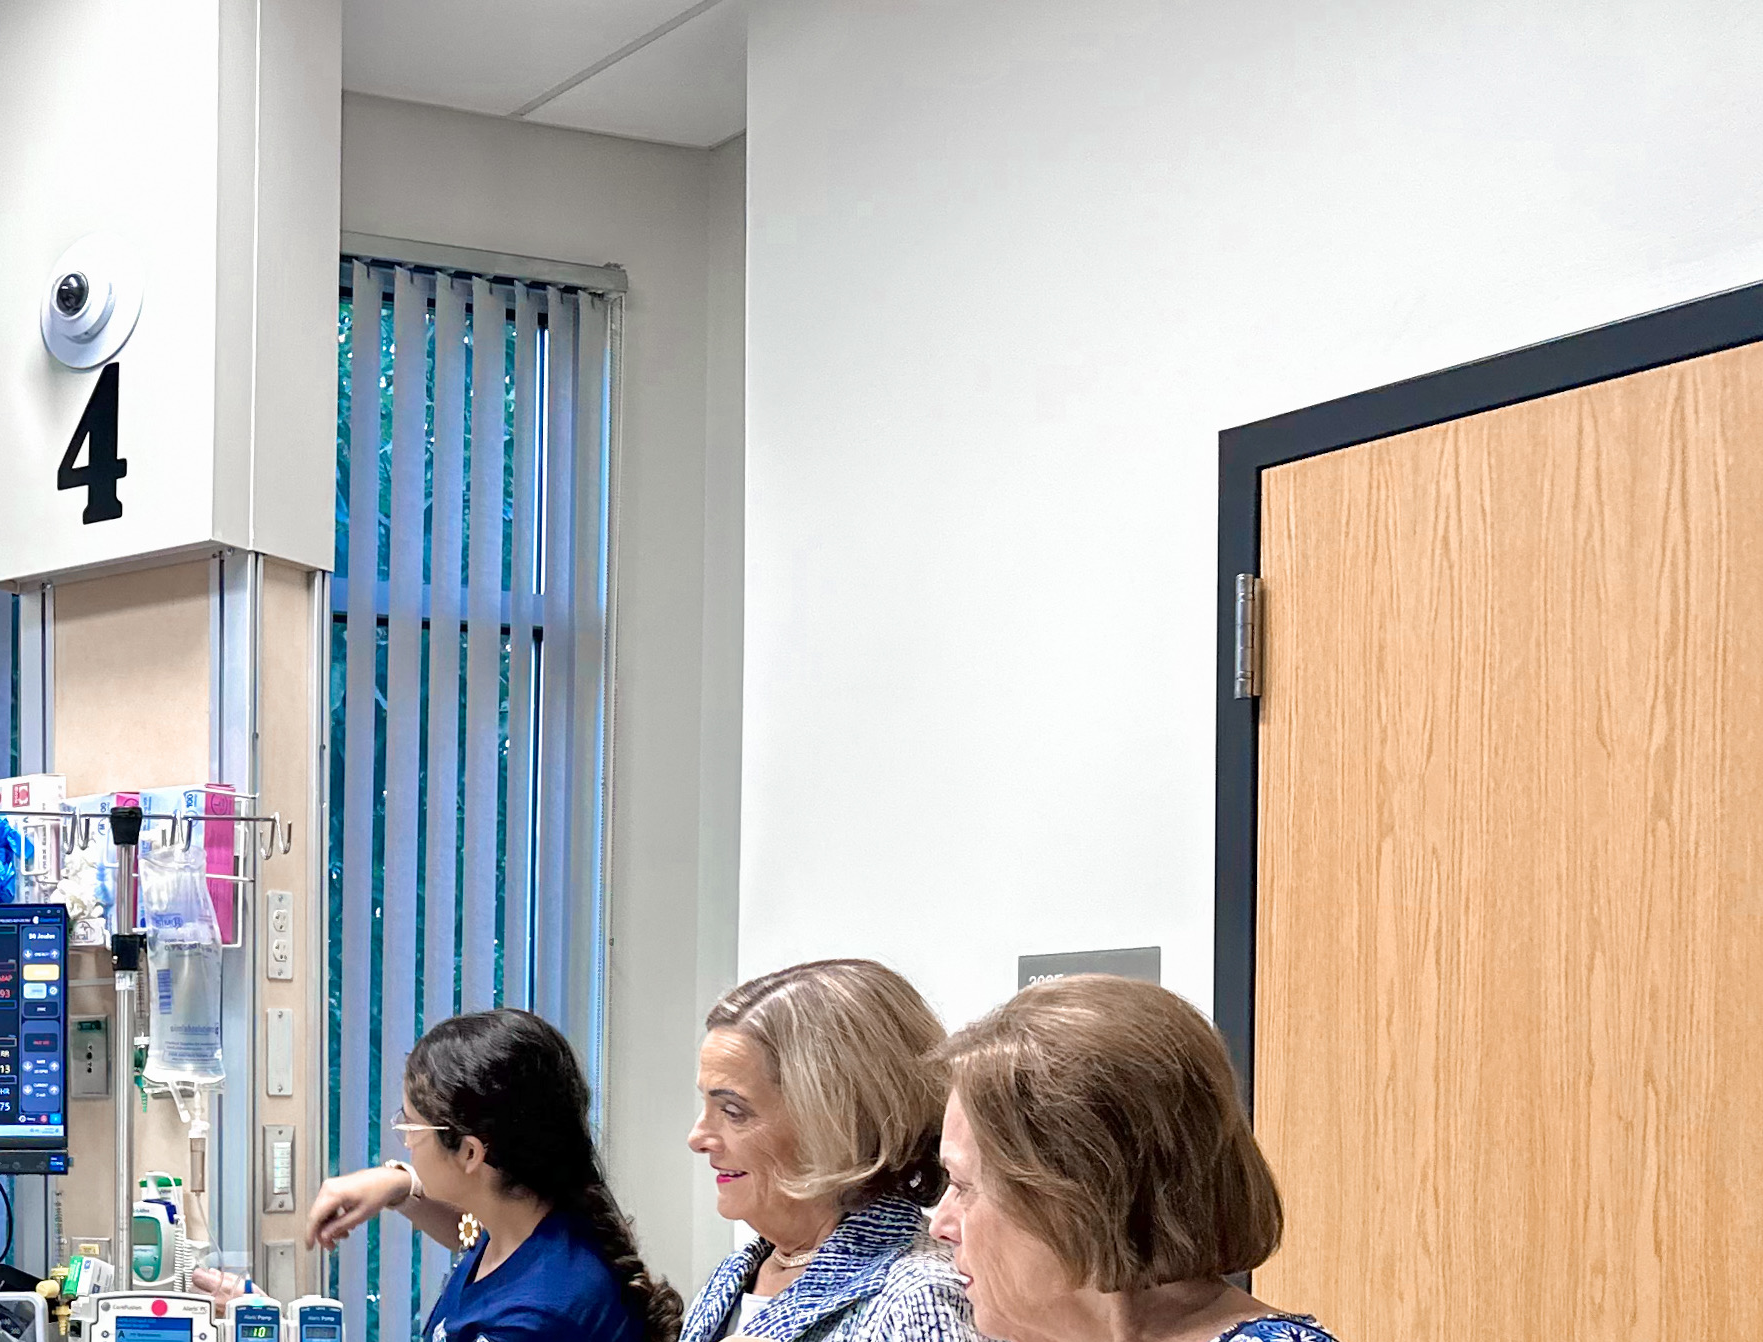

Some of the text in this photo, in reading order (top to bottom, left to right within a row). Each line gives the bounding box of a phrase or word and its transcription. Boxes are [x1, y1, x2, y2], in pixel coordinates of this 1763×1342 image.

[57, 362, 127, 525] 4
[0, 1064, 11, 1075] 13
[0, 1087, 11, 1096] HR
[252, 1326, 267, 1338] 10
